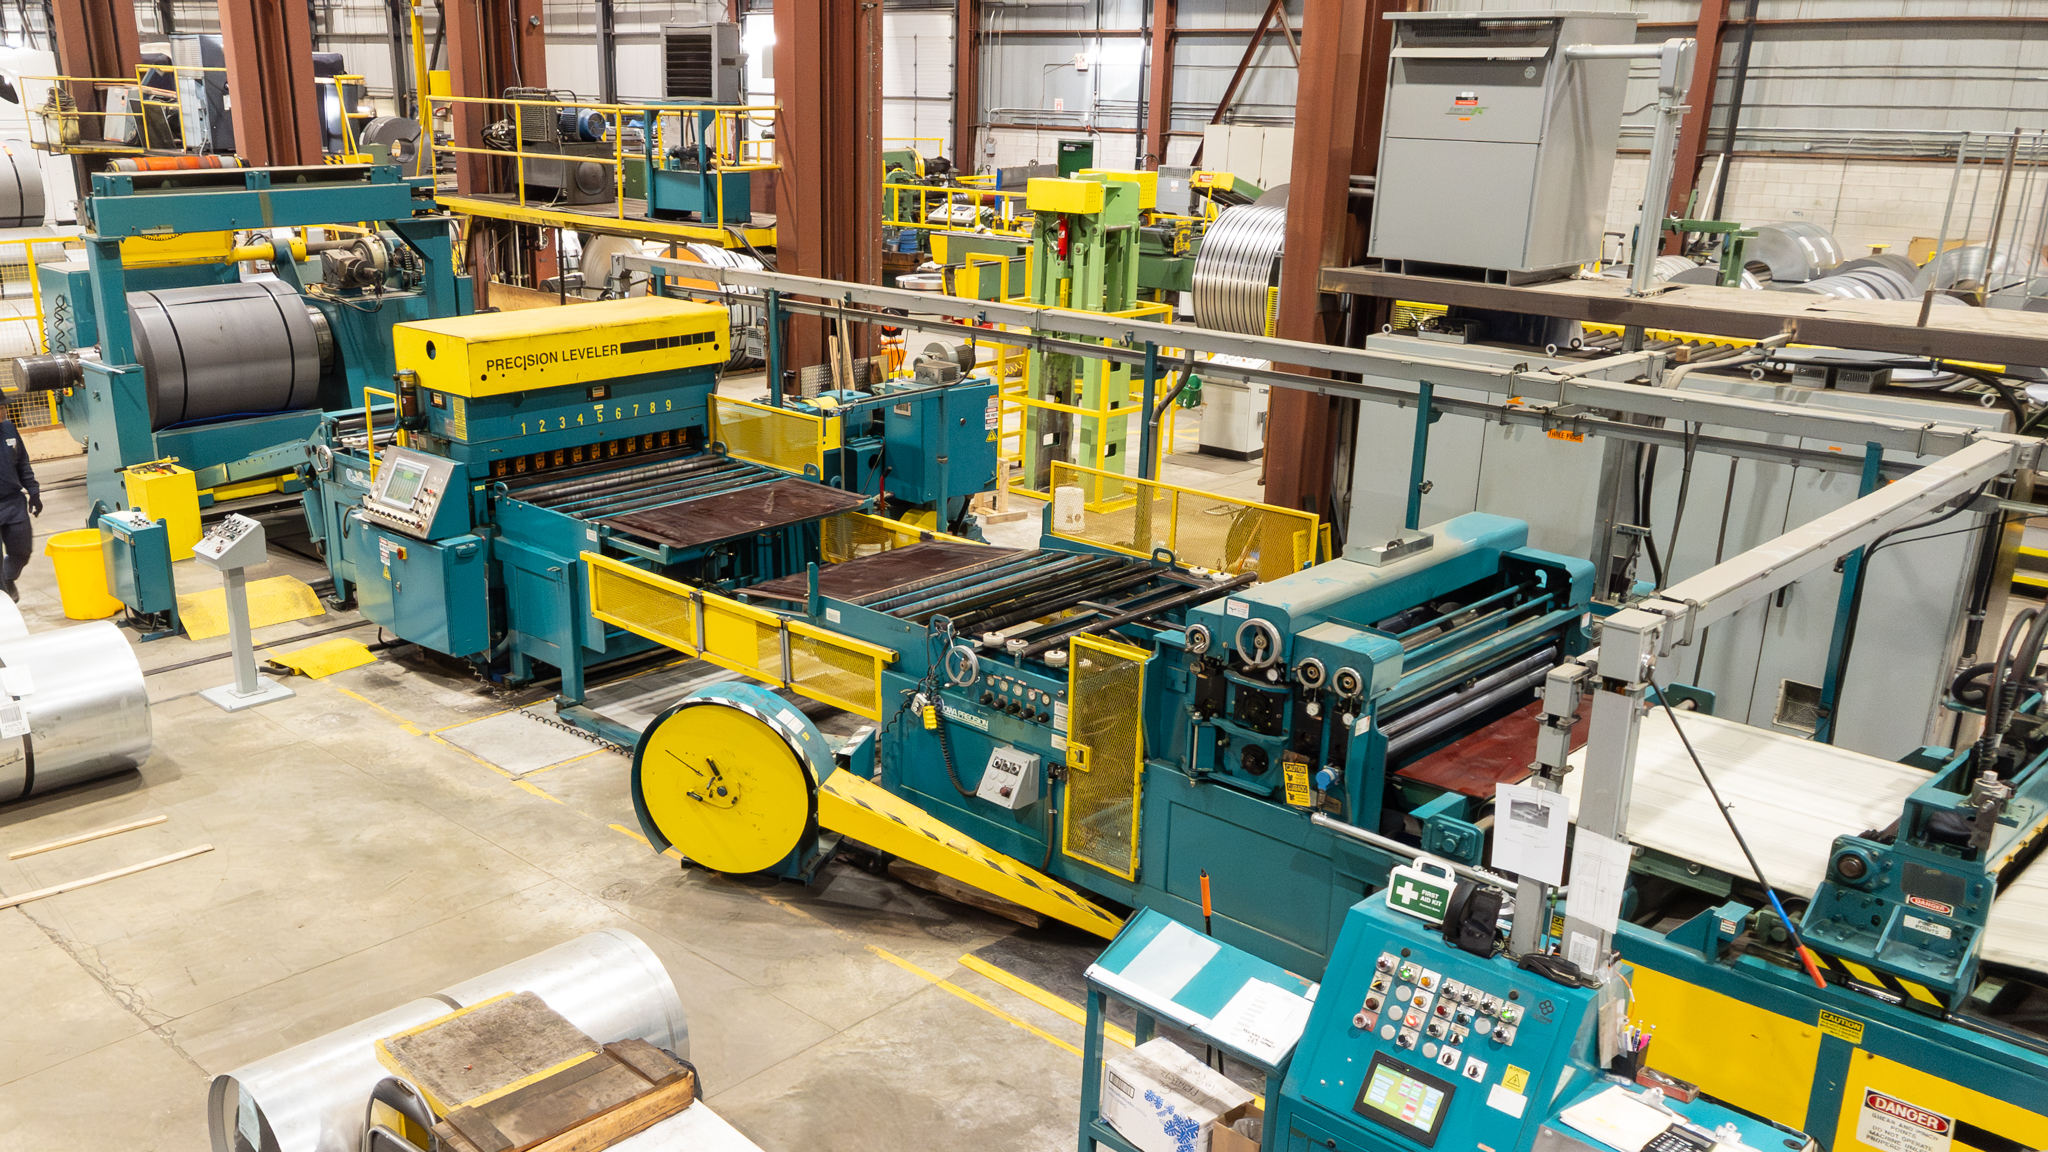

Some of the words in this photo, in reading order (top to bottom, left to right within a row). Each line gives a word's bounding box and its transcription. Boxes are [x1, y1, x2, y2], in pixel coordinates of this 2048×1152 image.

[486, 351, 558, 372] PRECISION
[562, 344, 619, 362] LEVELER
[520, 422, 527, 435] 1
[539, 420, 546, 432] 2
[559, 416, 566, 429] 3
[577, 413, 584, 425] 4
[597, 410, 604, 422] 5
[615, 407, 622, 419] 6
[633, 404, 640, 417] 7
[650, 402, 656, 414] 8
[665, 399, 672, 412] 9
[957, 710, 989, 727] PRECISION
[1419, 895, 1431, 904] AID
[1431, 899, 1443, 907] KIT
[1421, 889, 1440, 899] FIRST
[1915, 899, 1946, 911] DANGER
[1822, 1012, 1862, 1031] CAUTION
[1874, 1097, 1940, 1130] DANGER
[1871, 1112, 1896, 1125] SHEAR
[1898, 1123, 1914, 1132] AND
[1915, 1129, 1939, 1141] PINCH
[1890, 1125, 1917, 1139] POINTS
[1869, 1130, 1902, 1146] MACHINE
[1872, 1125, 1883, 1133] DO
[1884, 1130, 1899, 1139] NOT
[1901, 1136, 1934, 1151] OPERATE
